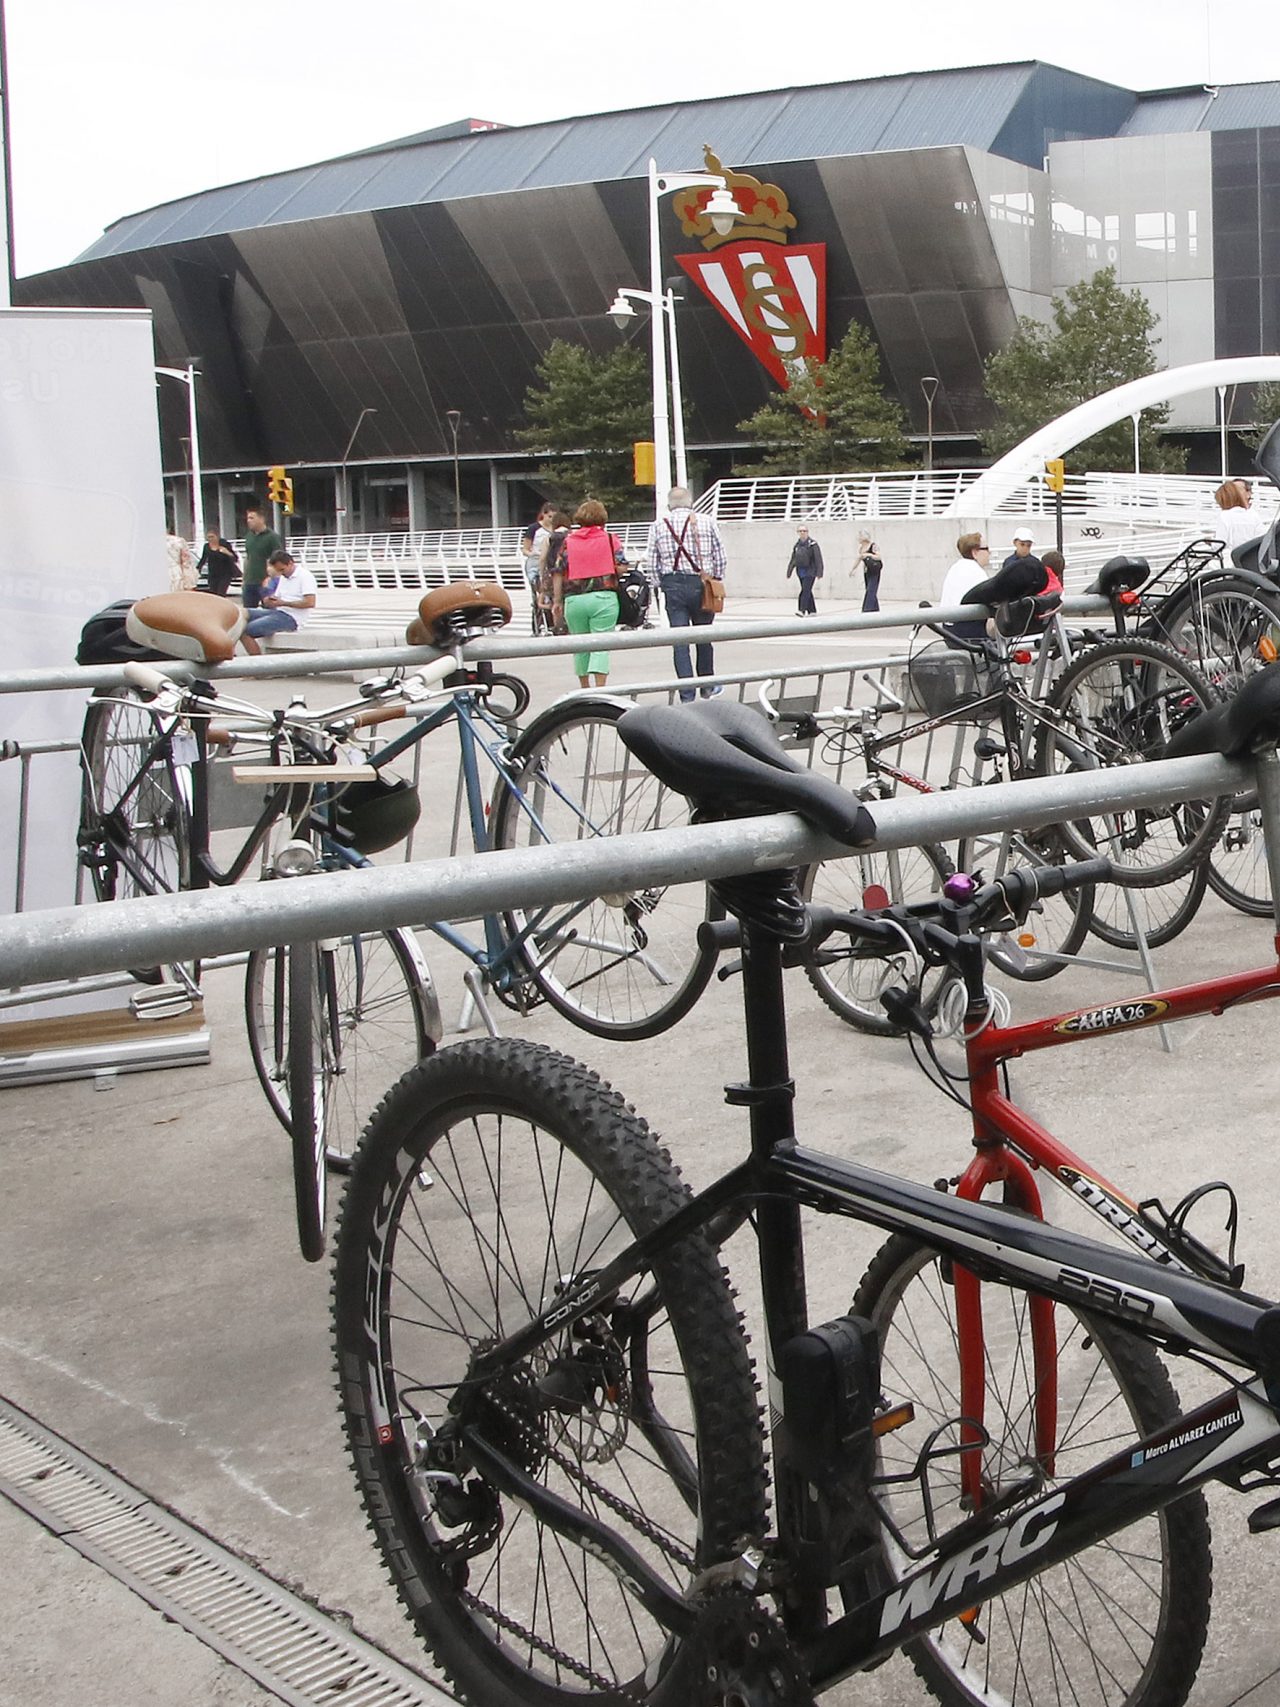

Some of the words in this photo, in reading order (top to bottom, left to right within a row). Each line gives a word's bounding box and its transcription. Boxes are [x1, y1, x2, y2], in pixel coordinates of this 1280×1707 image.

[1126, 1004, 1146, 1021] 26
[543, 1282, 600, 1329] CONOR
[1168, 1424, 1205, 1451] ALVAREZ
[879, 1492, 1067, 1638] WRC
